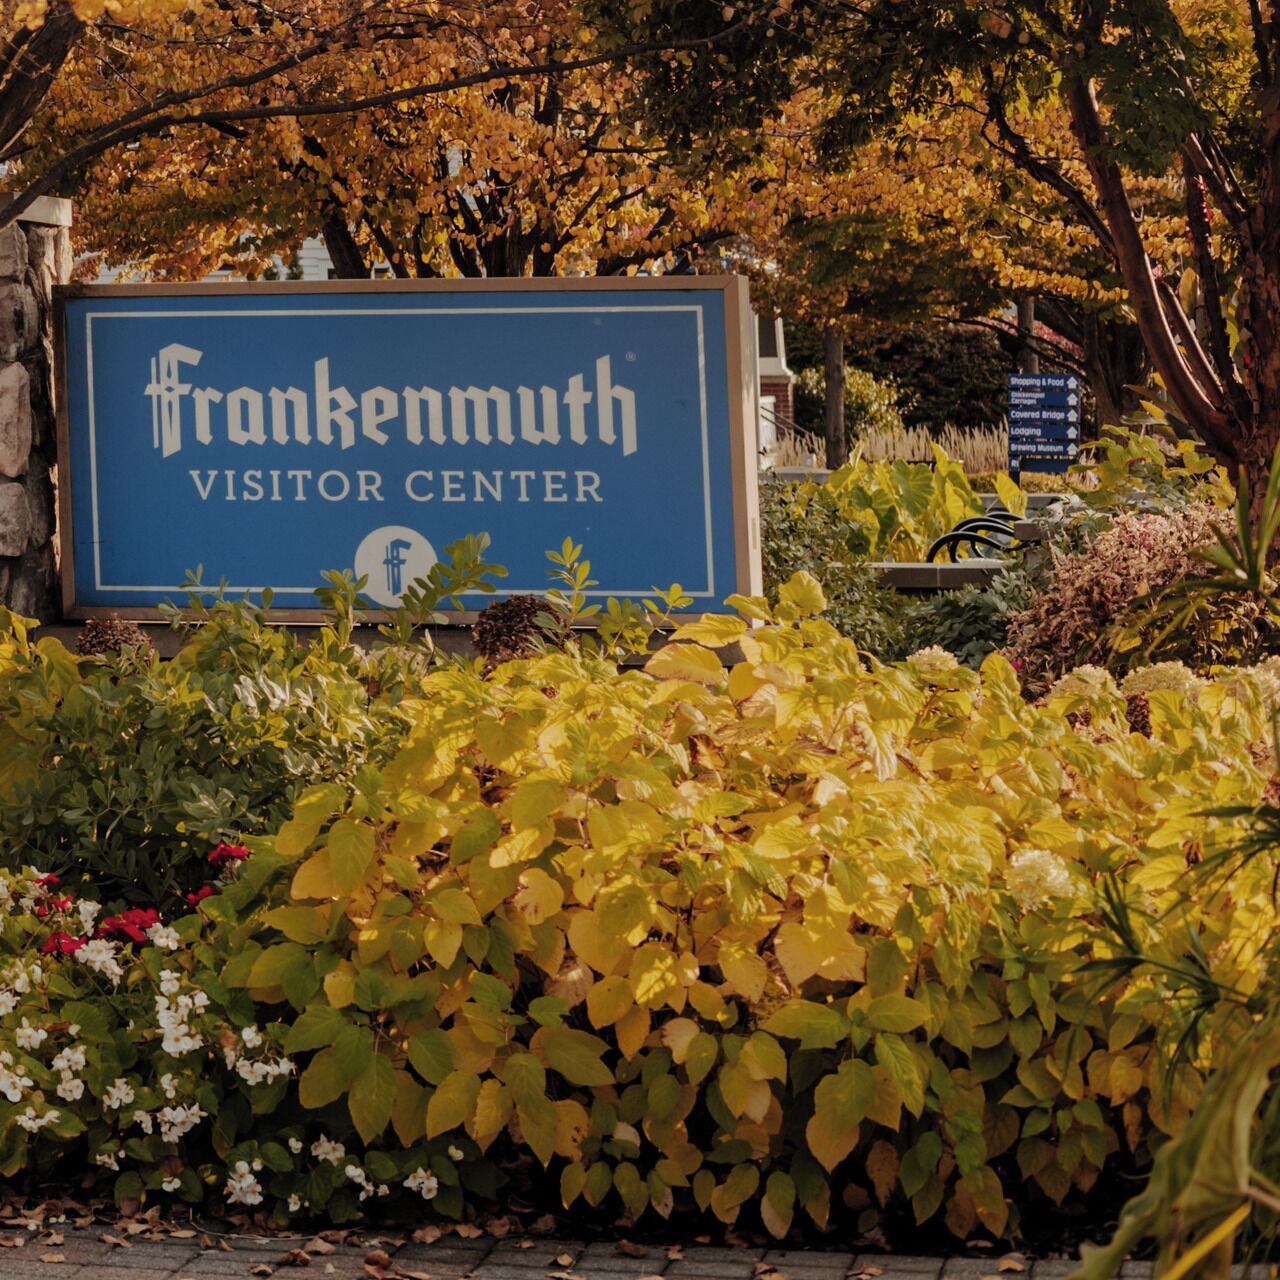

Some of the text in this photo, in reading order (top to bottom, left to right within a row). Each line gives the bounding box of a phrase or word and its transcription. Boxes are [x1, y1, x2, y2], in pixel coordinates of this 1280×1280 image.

[1011, 377, 1041, 386] Shopping
[1048, 378, 1065, 386] Food
[1011, 410, 1065, 420] Covered Bridge
[1011, 426, 1041, 436] Lodging
[1011, 443, 1064, 452] Brewing Museum
[189, 469, 604, 502] VISITOR CENTER
